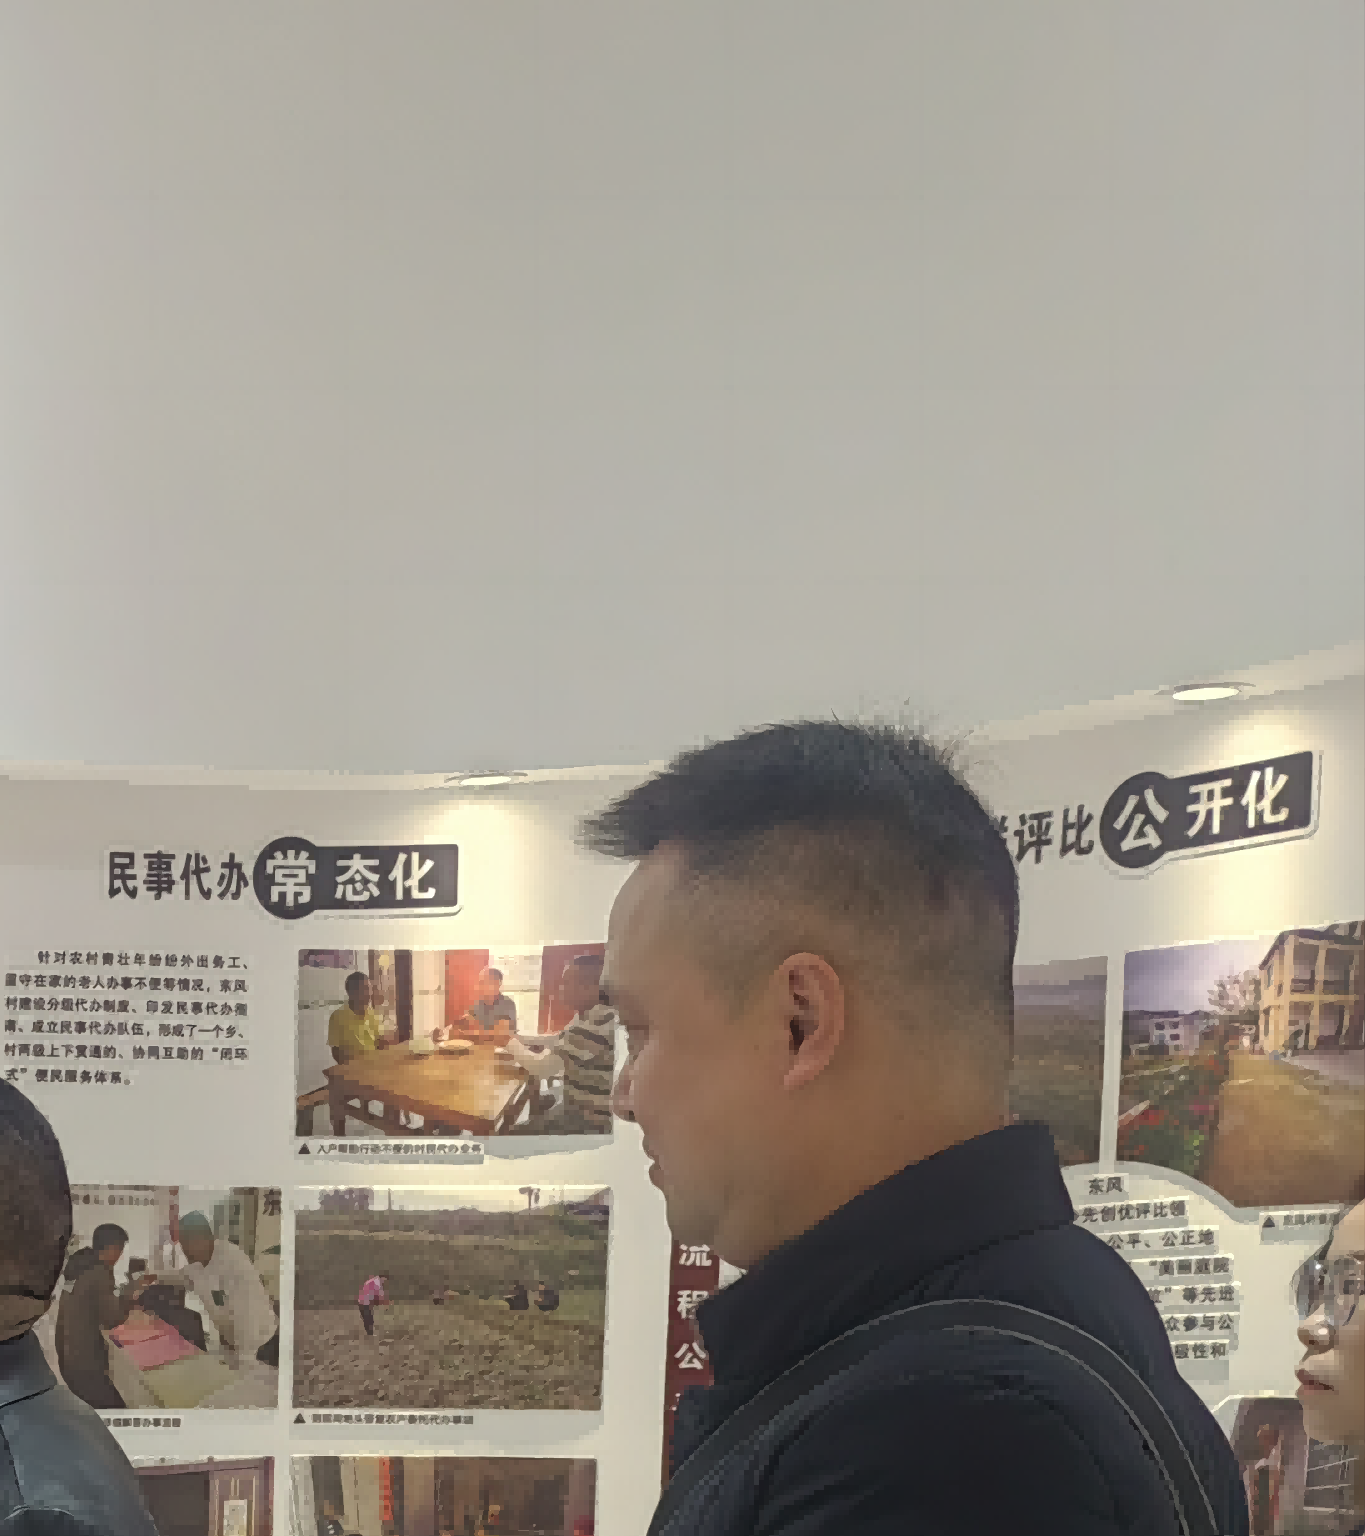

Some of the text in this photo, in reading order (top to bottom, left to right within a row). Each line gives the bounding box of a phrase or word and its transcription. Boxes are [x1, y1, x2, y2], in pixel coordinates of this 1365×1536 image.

[999, 766, 1290, 864] 评比公开化
[106, 847, 437, 908] 民事代办常态化
